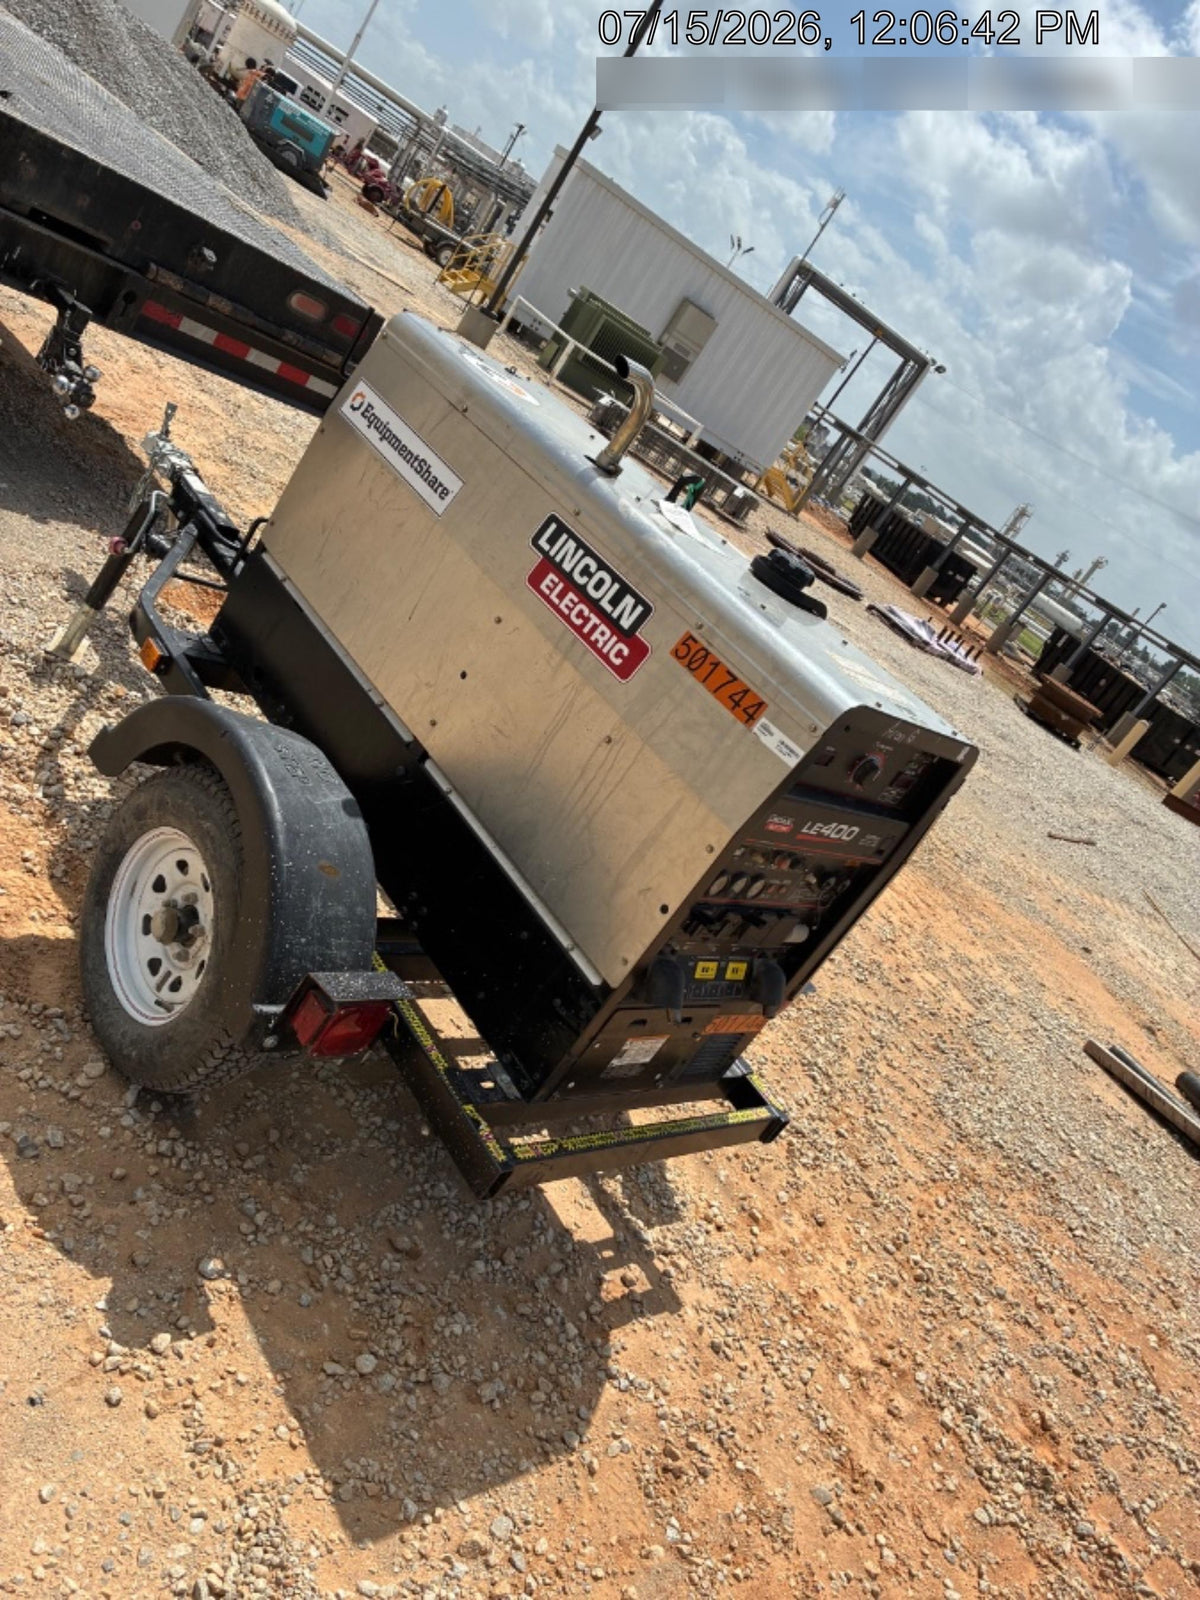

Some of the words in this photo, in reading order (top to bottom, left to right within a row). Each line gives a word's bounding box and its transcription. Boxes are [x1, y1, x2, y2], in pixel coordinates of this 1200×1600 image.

[360, 402, 451, 500] EquipmentShare
[537, 522, 644, 631] LINCOLN
[539, 572, 631, 667] ELECTRIC
[674, 636, 767, 725] 501744
[800, 820, 861, 842] LE400
